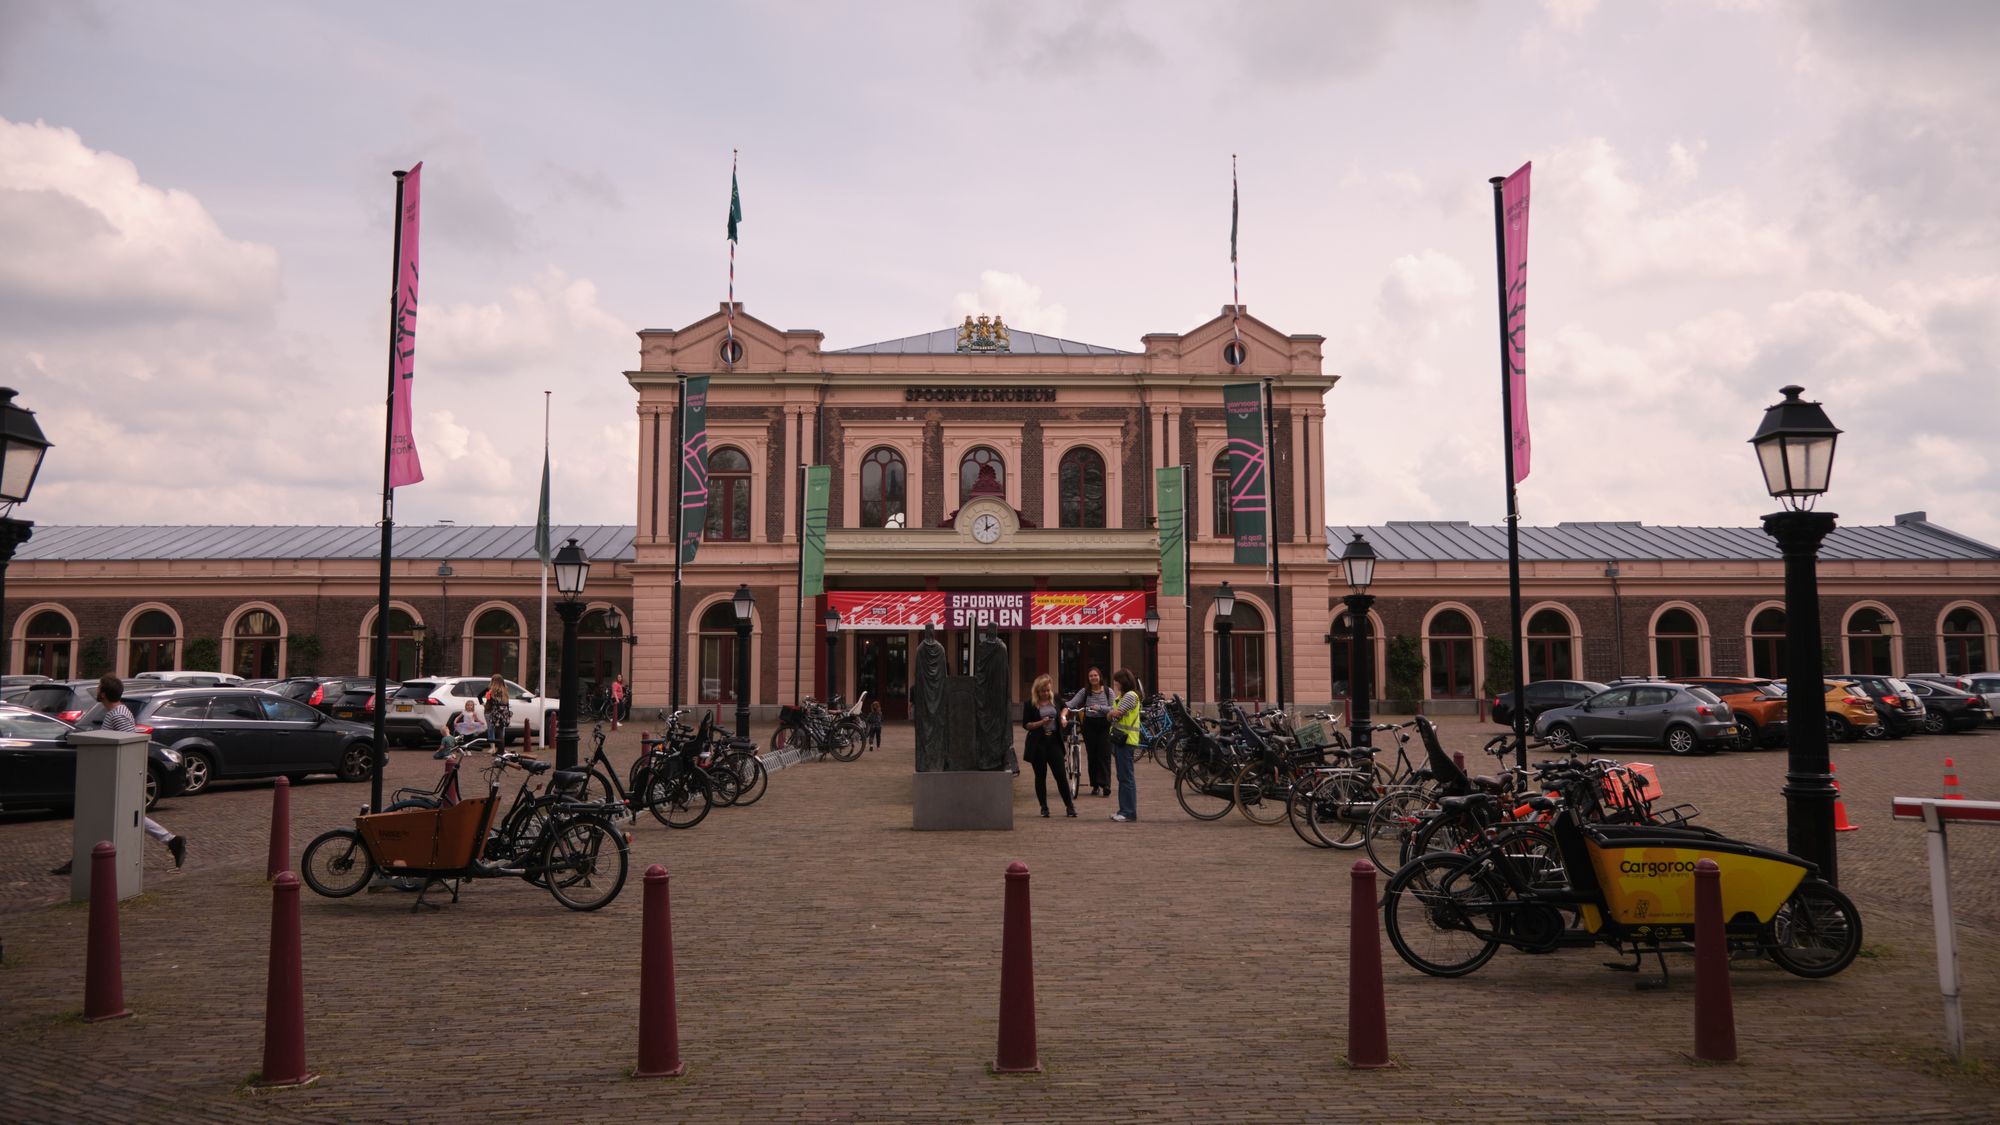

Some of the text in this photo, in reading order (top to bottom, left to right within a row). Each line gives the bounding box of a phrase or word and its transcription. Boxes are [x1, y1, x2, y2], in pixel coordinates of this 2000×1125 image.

[905, 388, 1056, 402] SPOORWEGMUSEUM
[952, 595, 1023, 608] SPOORWEG
[1620, 861, 1695, 877] Cargoroo
